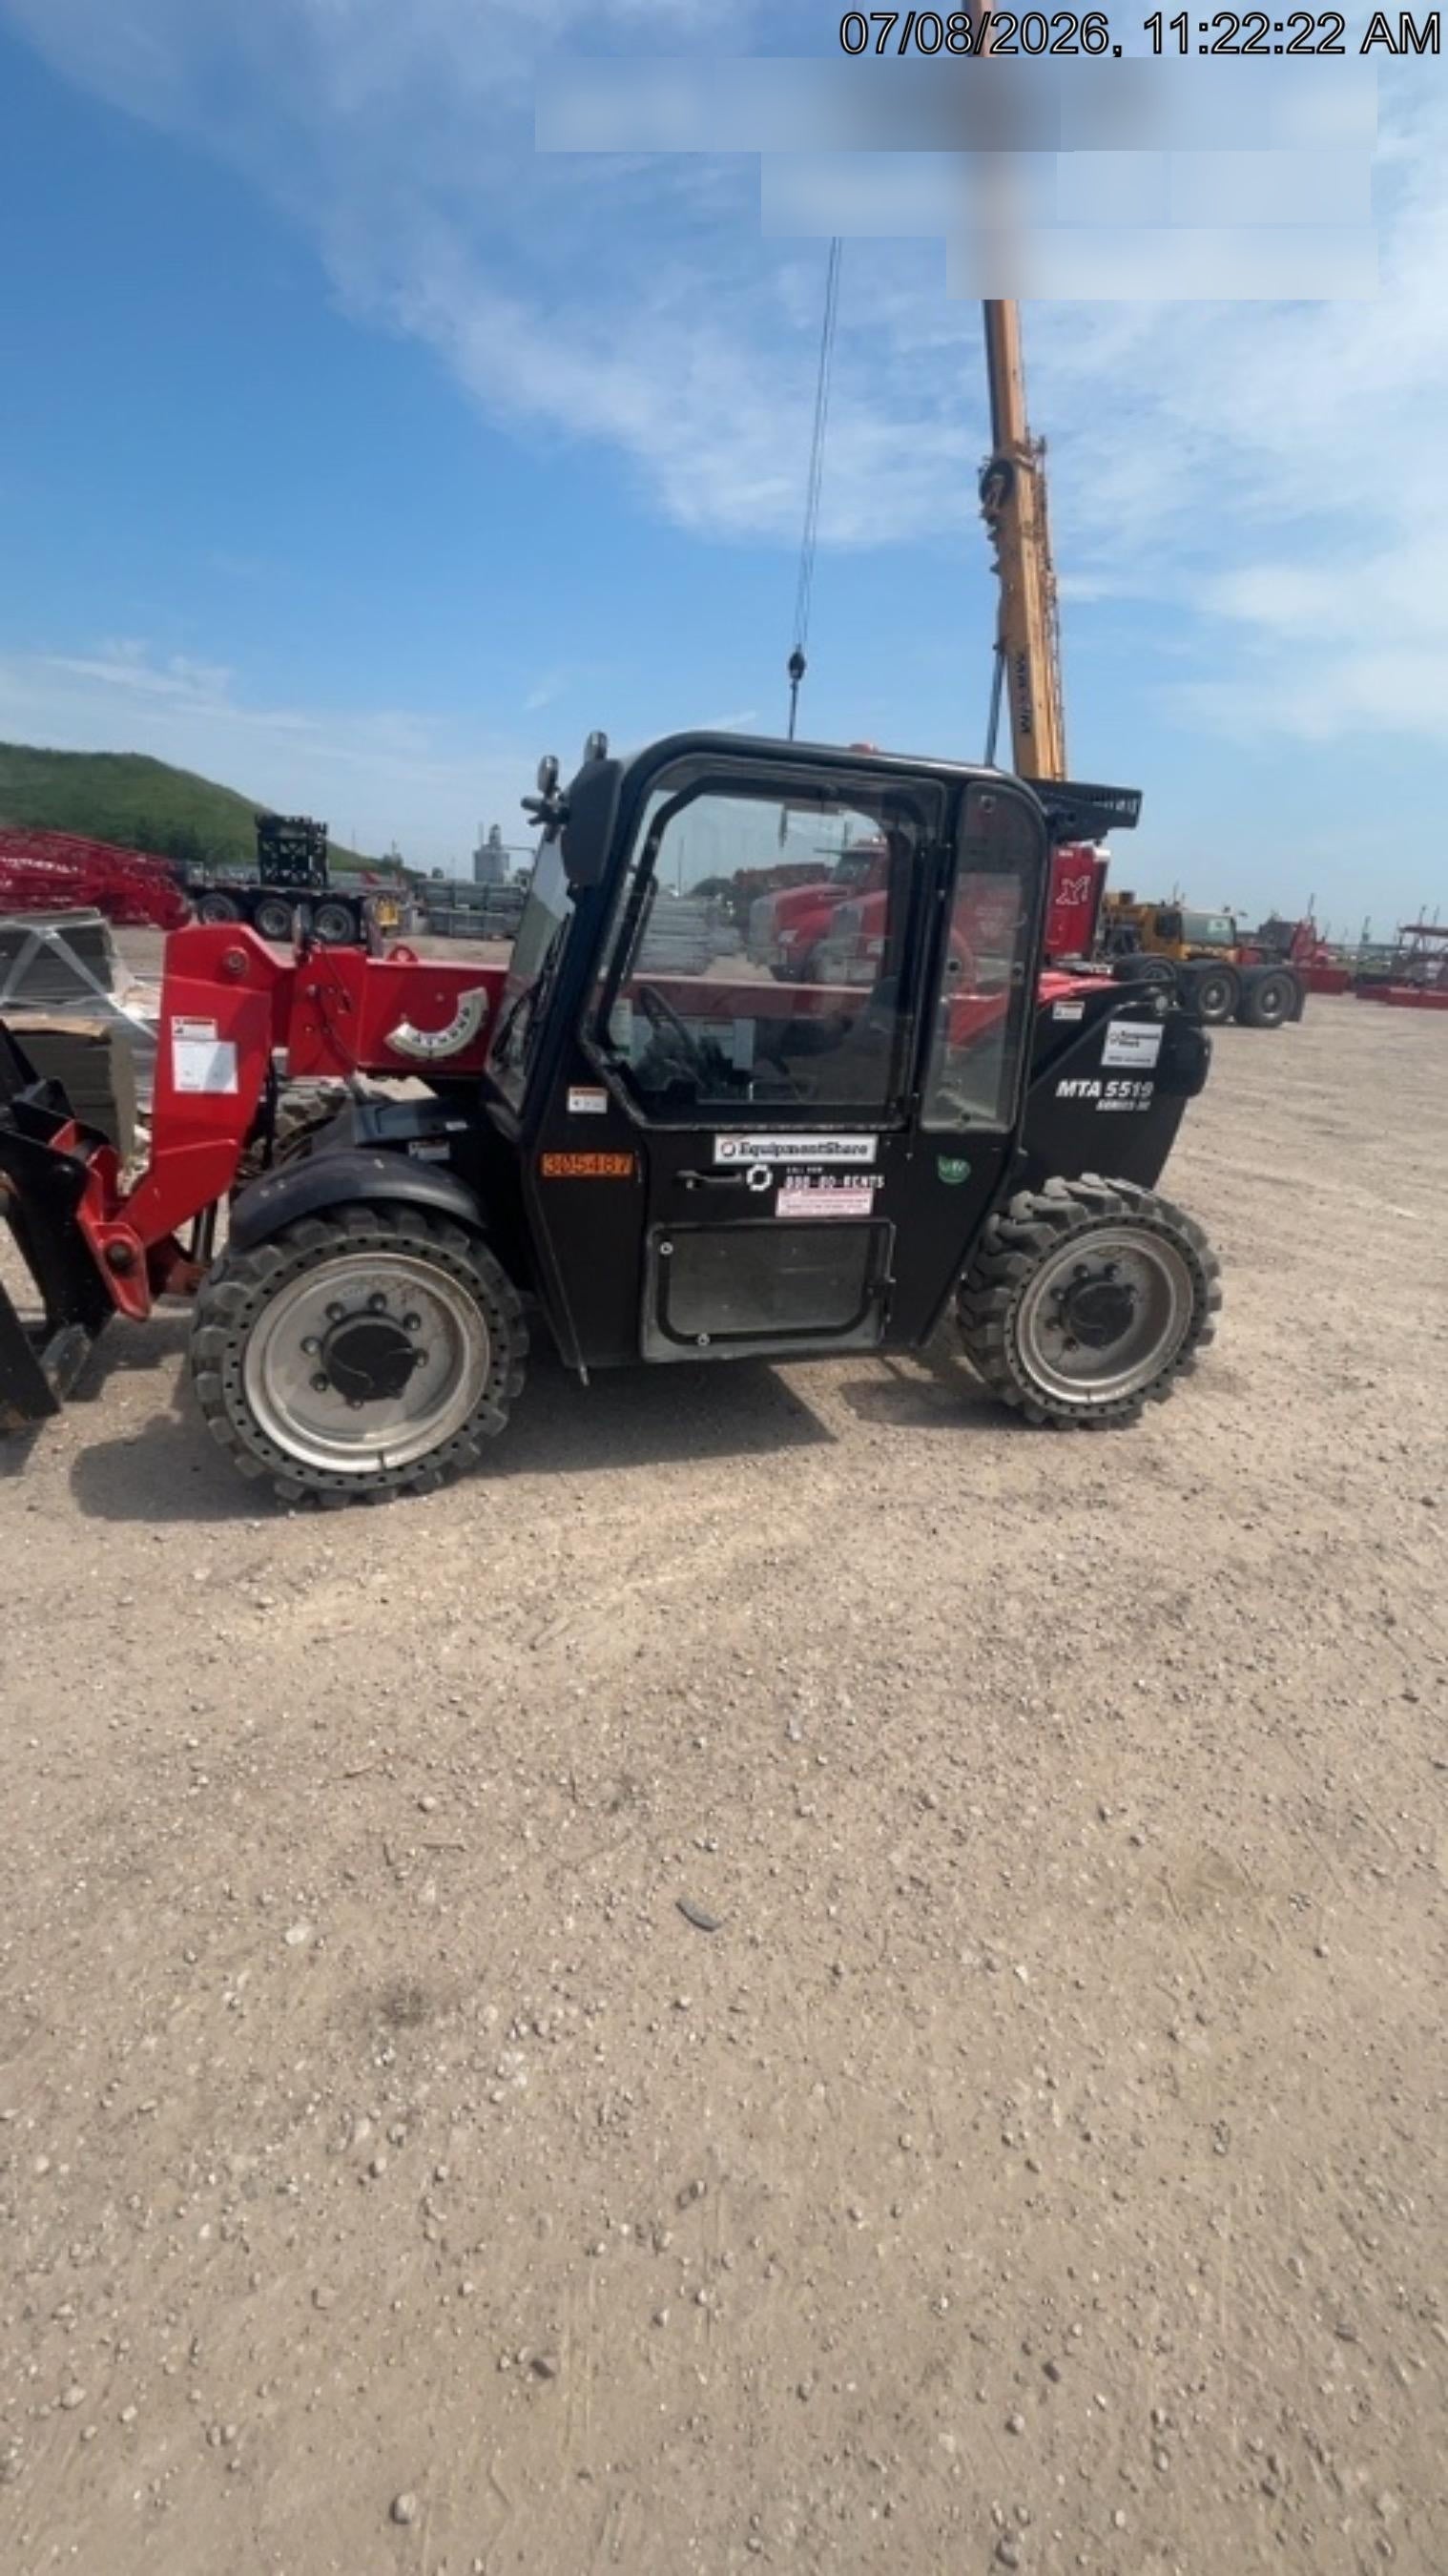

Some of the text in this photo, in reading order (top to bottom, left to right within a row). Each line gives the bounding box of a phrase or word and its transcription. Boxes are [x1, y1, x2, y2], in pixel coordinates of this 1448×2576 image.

[1055, 1079, 1154, 1098] MTA 5519
[739, 1141, 868, 1157] EquipmentShare
